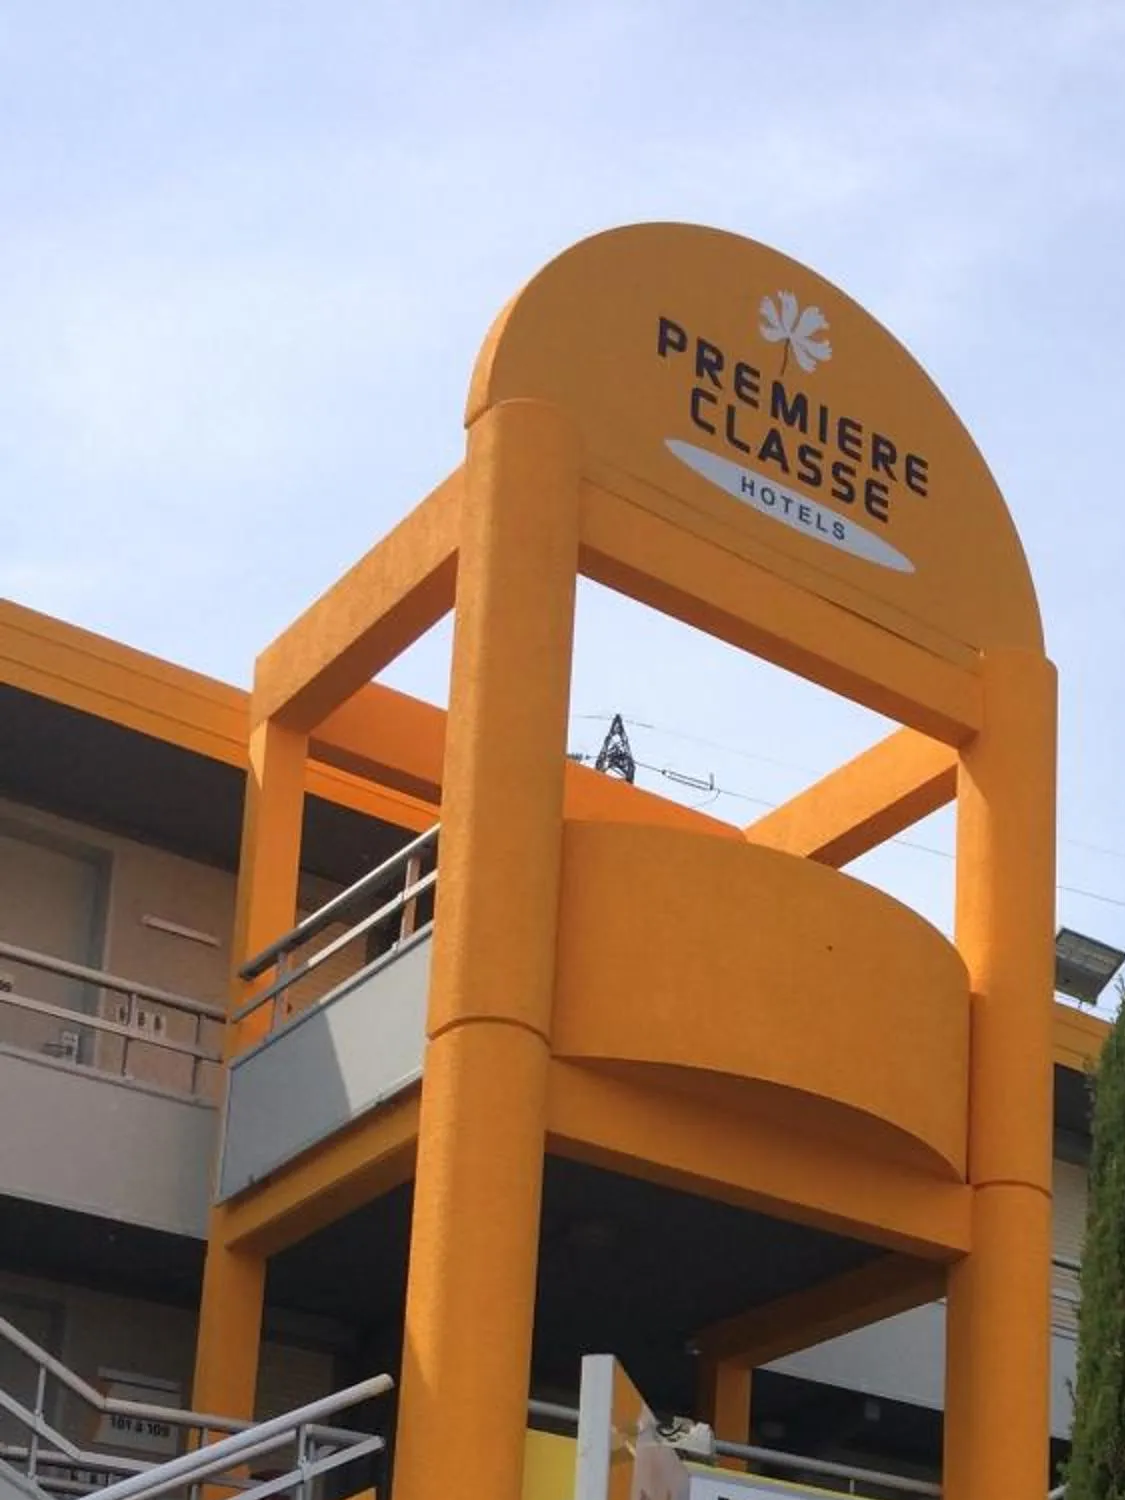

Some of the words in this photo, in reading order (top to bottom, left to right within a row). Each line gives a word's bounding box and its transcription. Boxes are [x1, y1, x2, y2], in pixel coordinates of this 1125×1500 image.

[657, 316, 929, 498] PREMIERE
[690, 388, 890, 523] CLASSE
[740, 475, 846, 541] HOTELS
